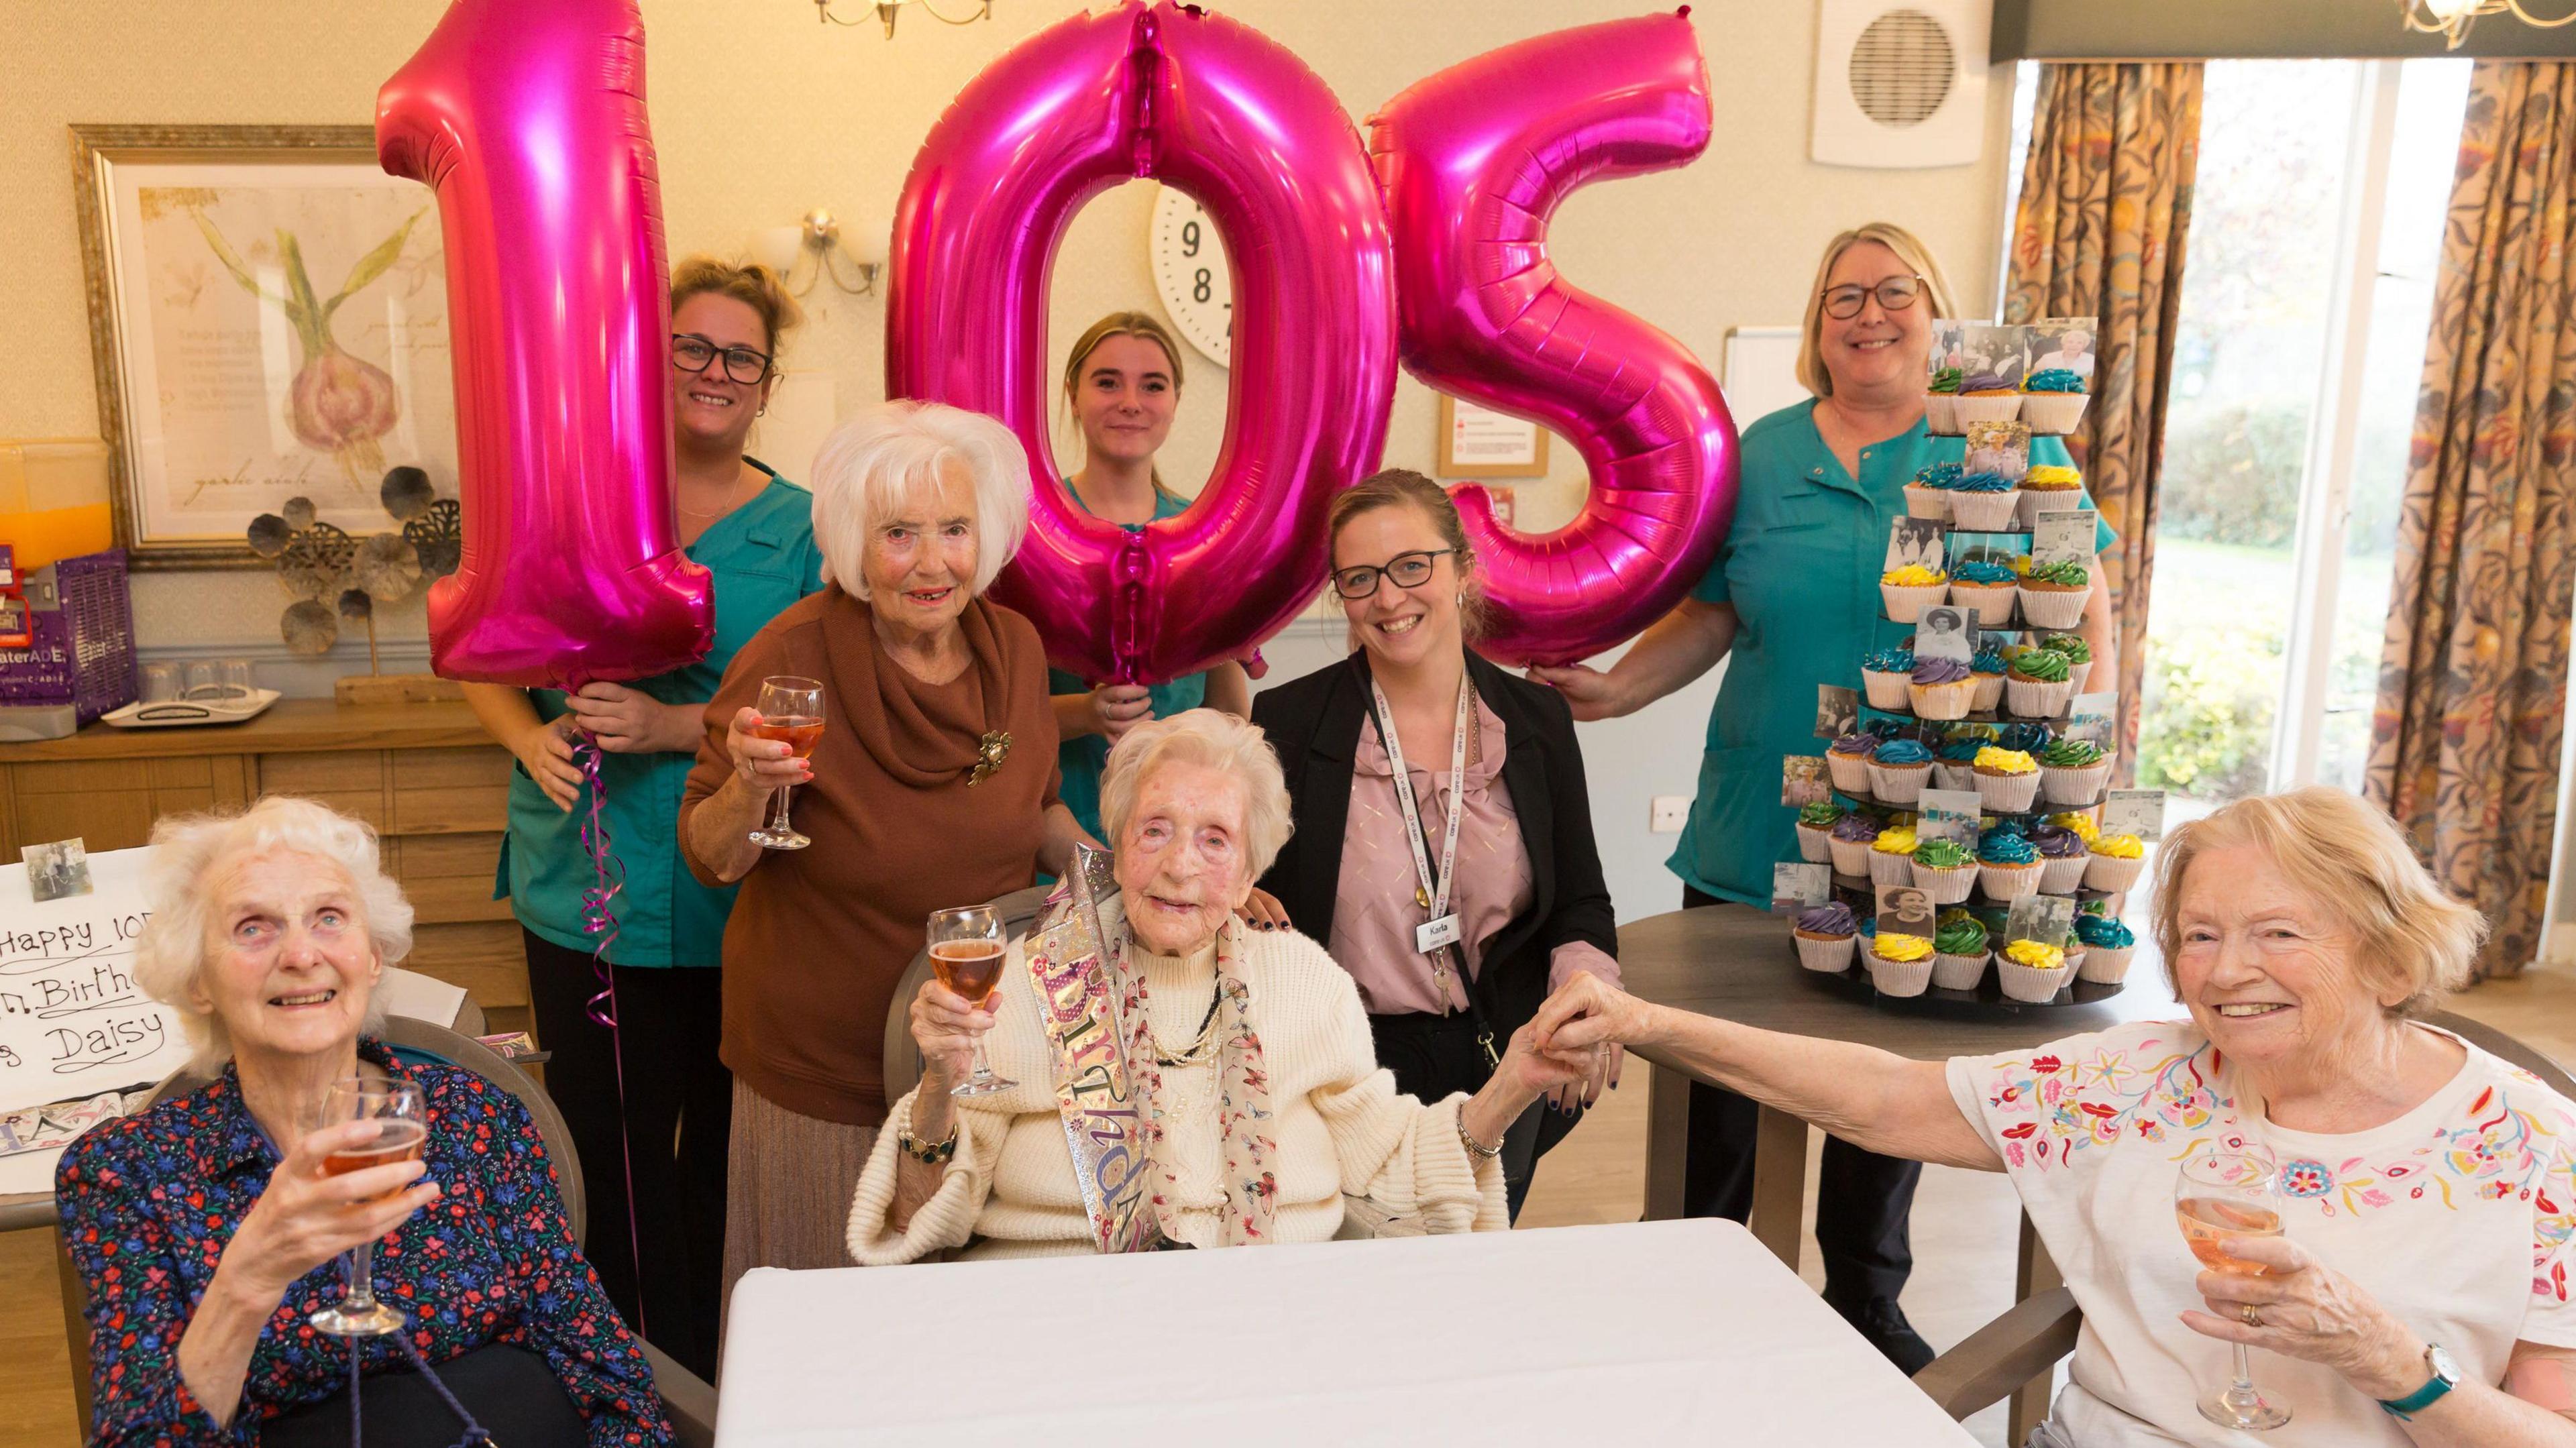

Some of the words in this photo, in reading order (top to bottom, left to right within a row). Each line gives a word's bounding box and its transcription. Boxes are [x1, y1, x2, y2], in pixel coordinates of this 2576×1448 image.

[1183, 221, 1200, 258] 9
[1193, 268, 1211, 303] 8
[0, 922, 92, 958] Happy
[1430, 923, 1448, 936] Karla
[44, 1013, 165, 1061] Daisy
